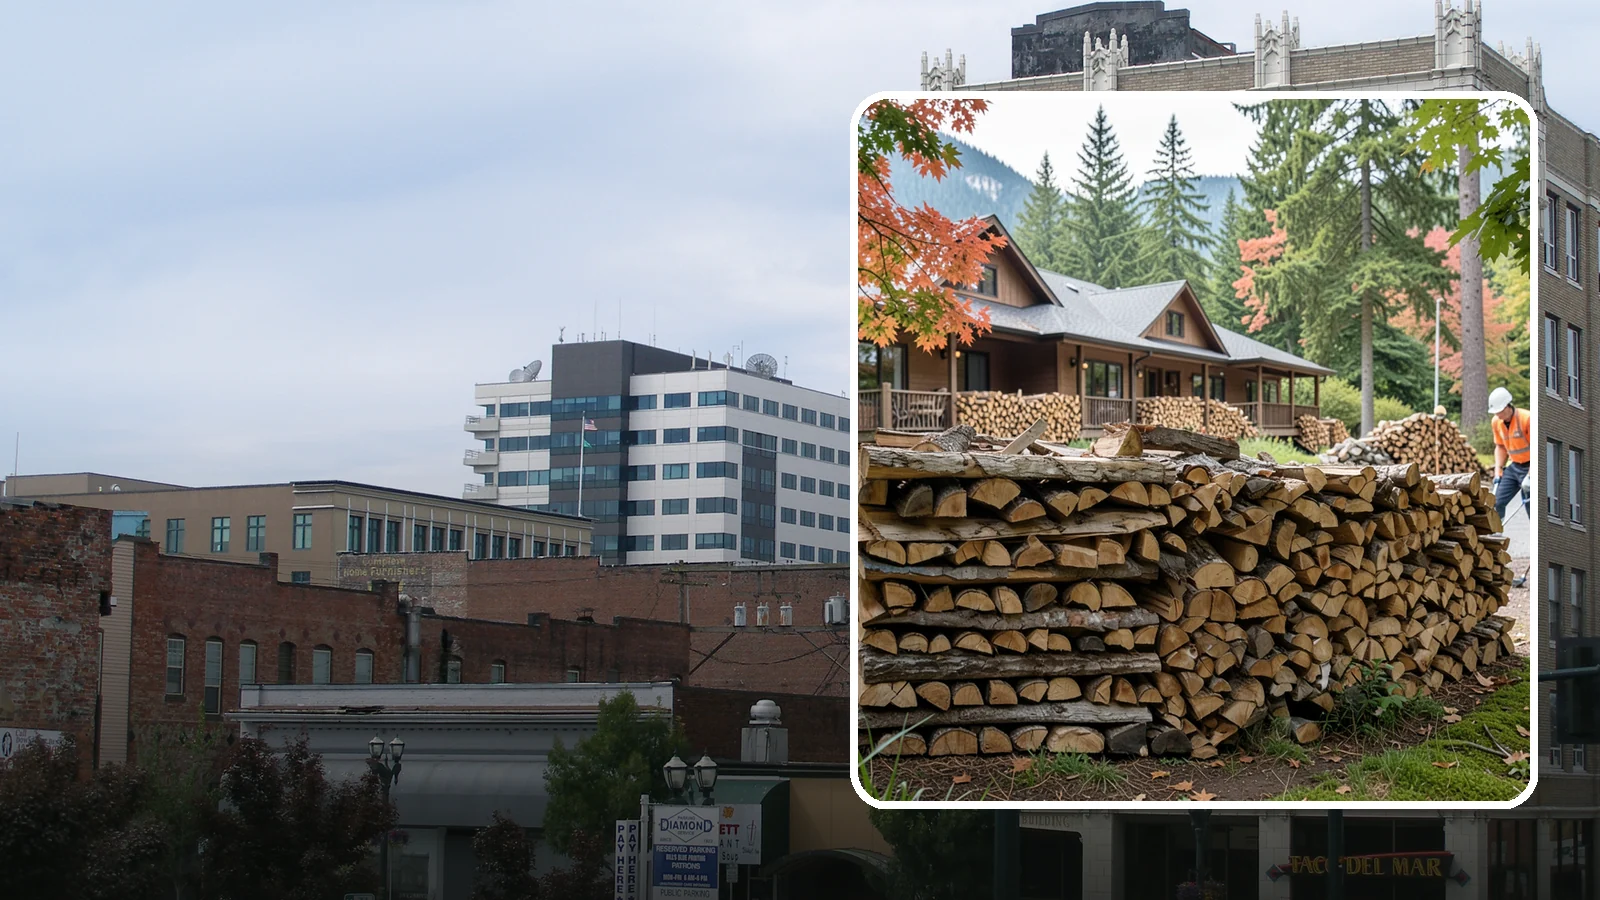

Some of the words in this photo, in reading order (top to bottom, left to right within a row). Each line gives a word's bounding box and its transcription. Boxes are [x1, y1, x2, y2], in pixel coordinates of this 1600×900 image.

[660, 818, 713, 833] DIAMOND
[1022, 815, 1069, 827] BUILDING
[617, 825, 625, 852] PAY
[628, 824, 636, 852] PAY
[655, 845, 688, 853] RESERVED
[689, 846, 716, 854] PARKING
[721, 851, 739, 862] Soup
[671, 862, 701, 870] PATRONS
[1346, 856, 1385, 875] DEL
[1392, 857, 1442, 877] MAR
[617, 856, 625, 894] HERE
[628, 856, 636, 894] HERE
[660, 889, 682, 897] PUBLIC
[683, 890, 710, 898] PARKING
